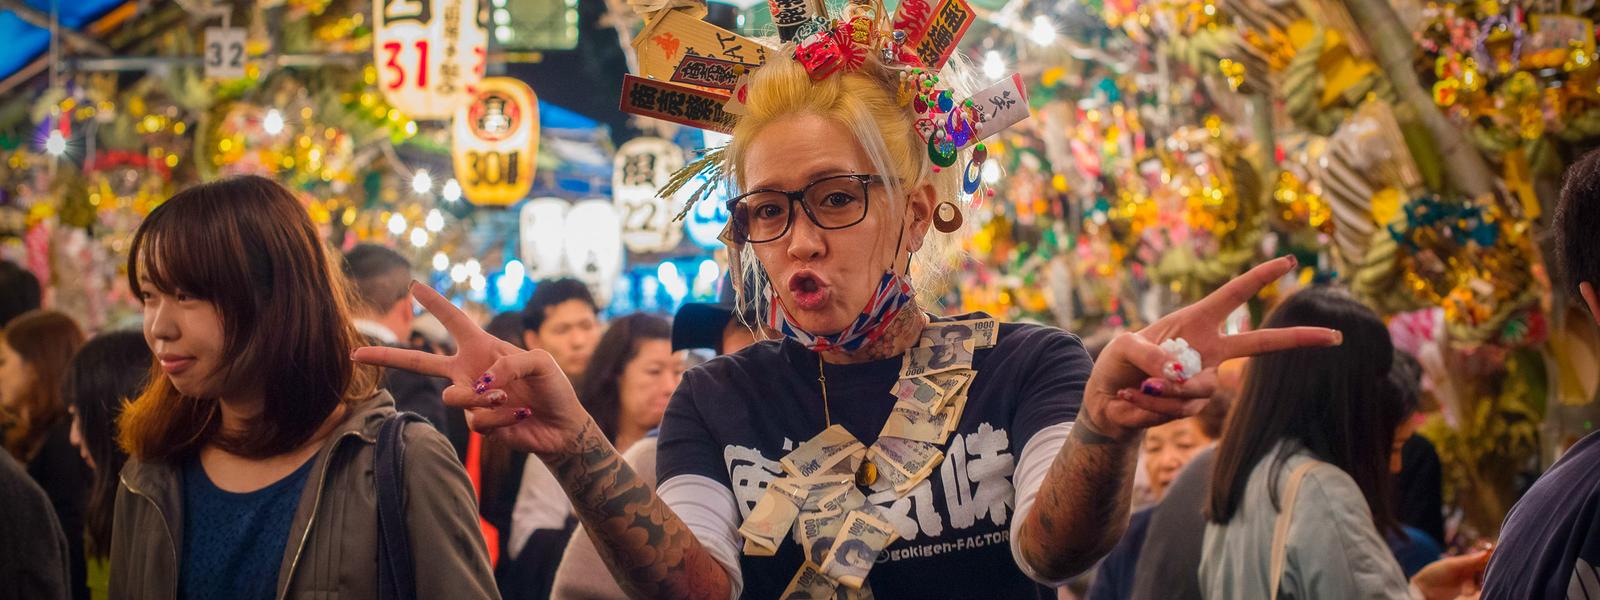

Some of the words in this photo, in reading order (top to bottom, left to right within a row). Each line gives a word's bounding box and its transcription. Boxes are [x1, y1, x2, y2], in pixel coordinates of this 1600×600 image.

[208, 41, 243, 68] 32
[384, 40, 428, 92] 31
[974, 320, 994, 330] 1000
[804, 519, 817, 539] 1000
[847, 517, 866, 537] 1000
